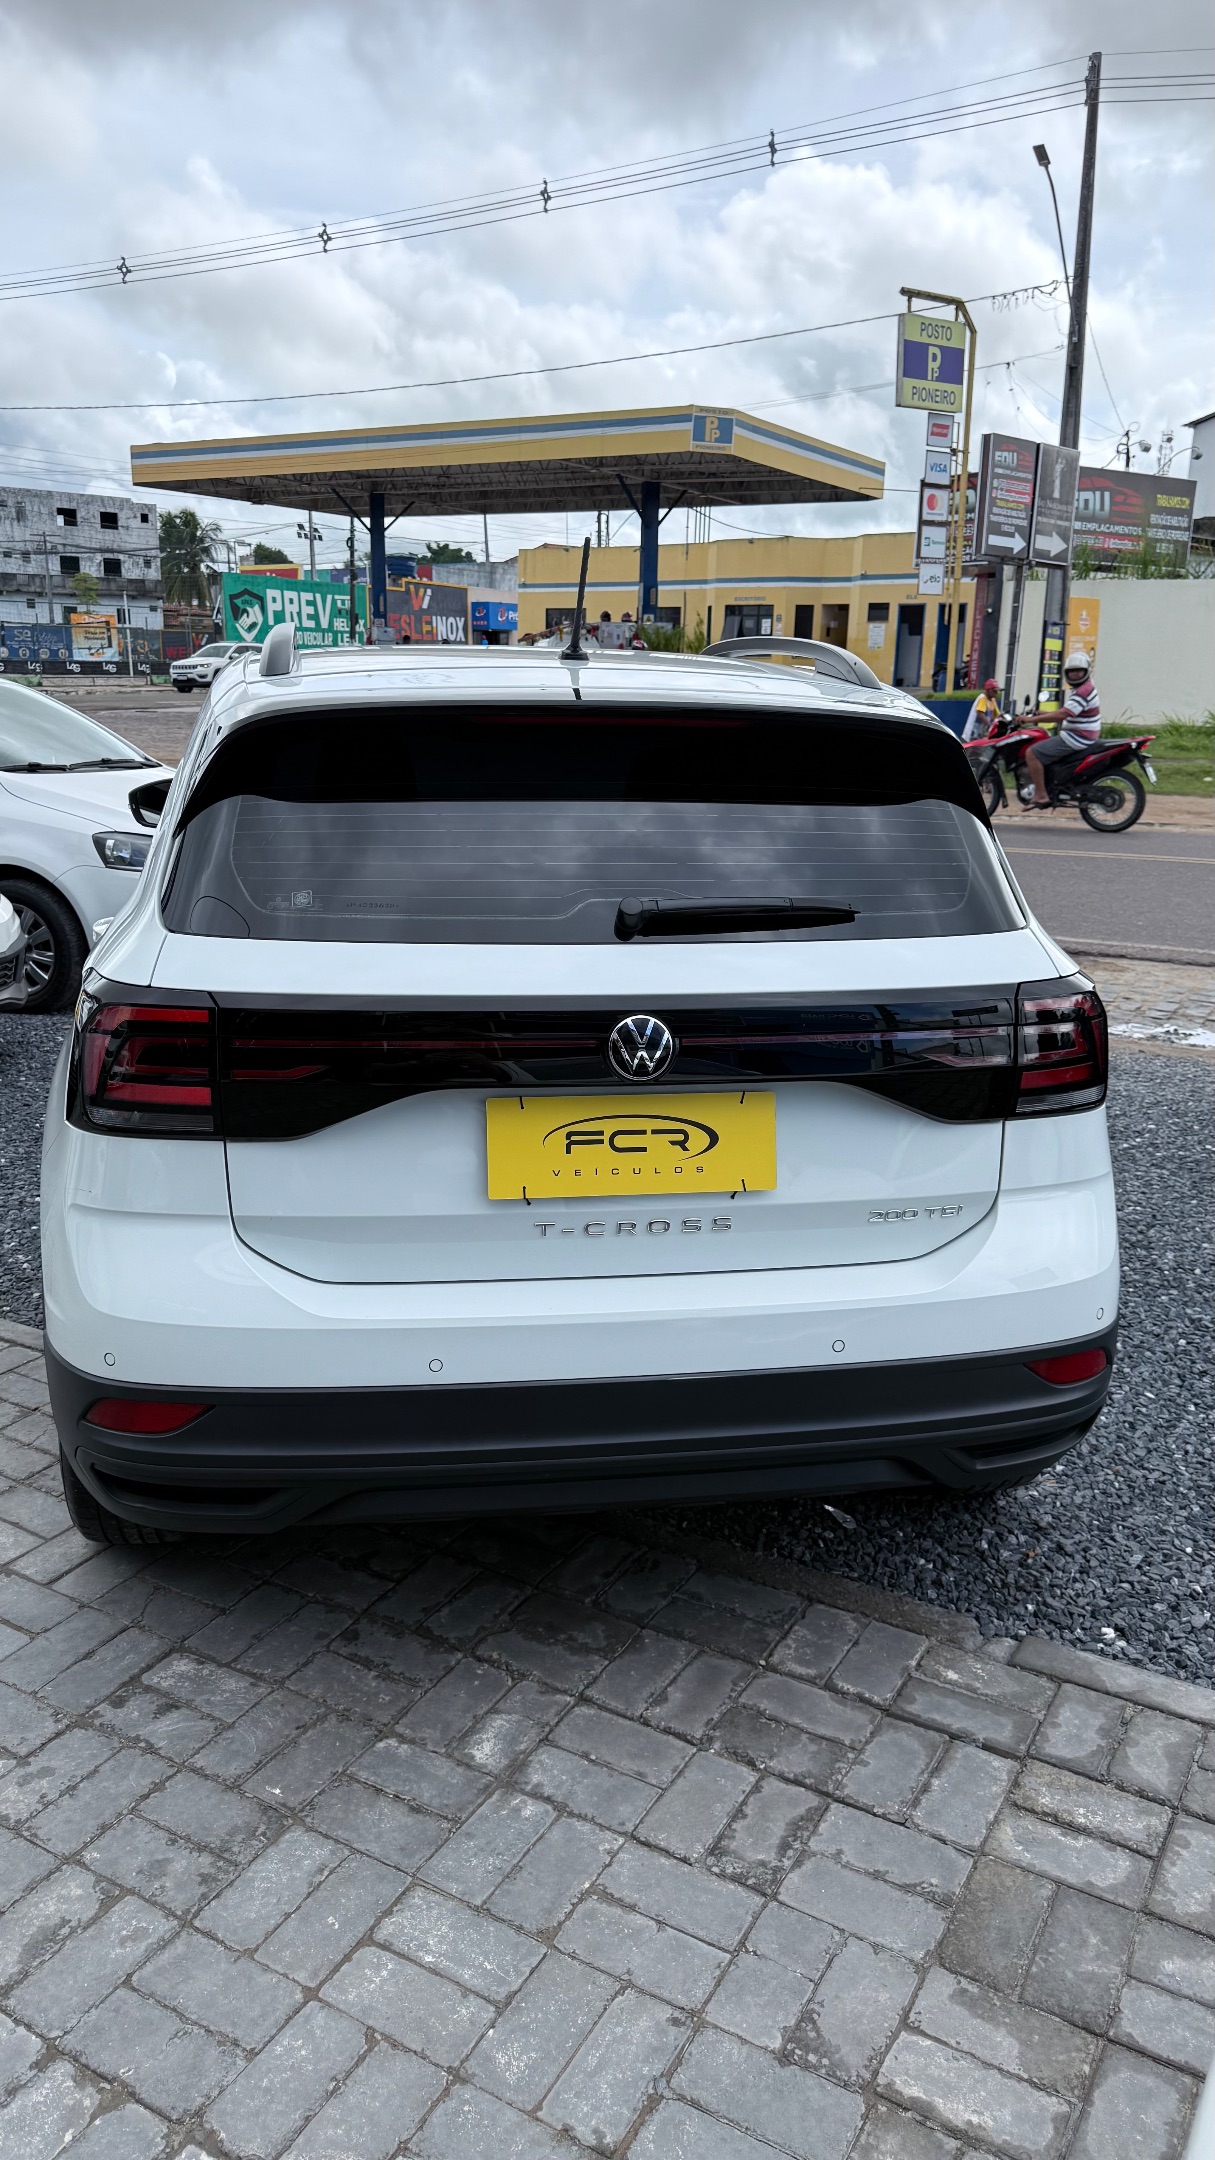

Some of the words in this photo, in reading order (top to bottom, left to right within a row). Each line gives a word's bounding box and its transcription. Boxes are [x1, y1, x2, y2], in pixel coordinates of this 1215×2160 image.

[920, 322, 953, 342] POSTO
[911, 385, 956, 406] PIONEIRO
[929, 462, 948, 474] VISA
[1075, 490, 1111, 520] DU
[1081, 522, 1143, 536] EMPLACAMENTOS
[265, 588, 333, 629] PREV
[303, 631, 334, 646] VEICULAR
[565, 1128, 691, 1155] FCR
[552, 1165, 704, 1178] VEÍCULOS
[868, 1207, 919, 1223] 200
[924, 1203, 964, 1219] TSI
[533, 1215, 733, 1238] T-CROSS
